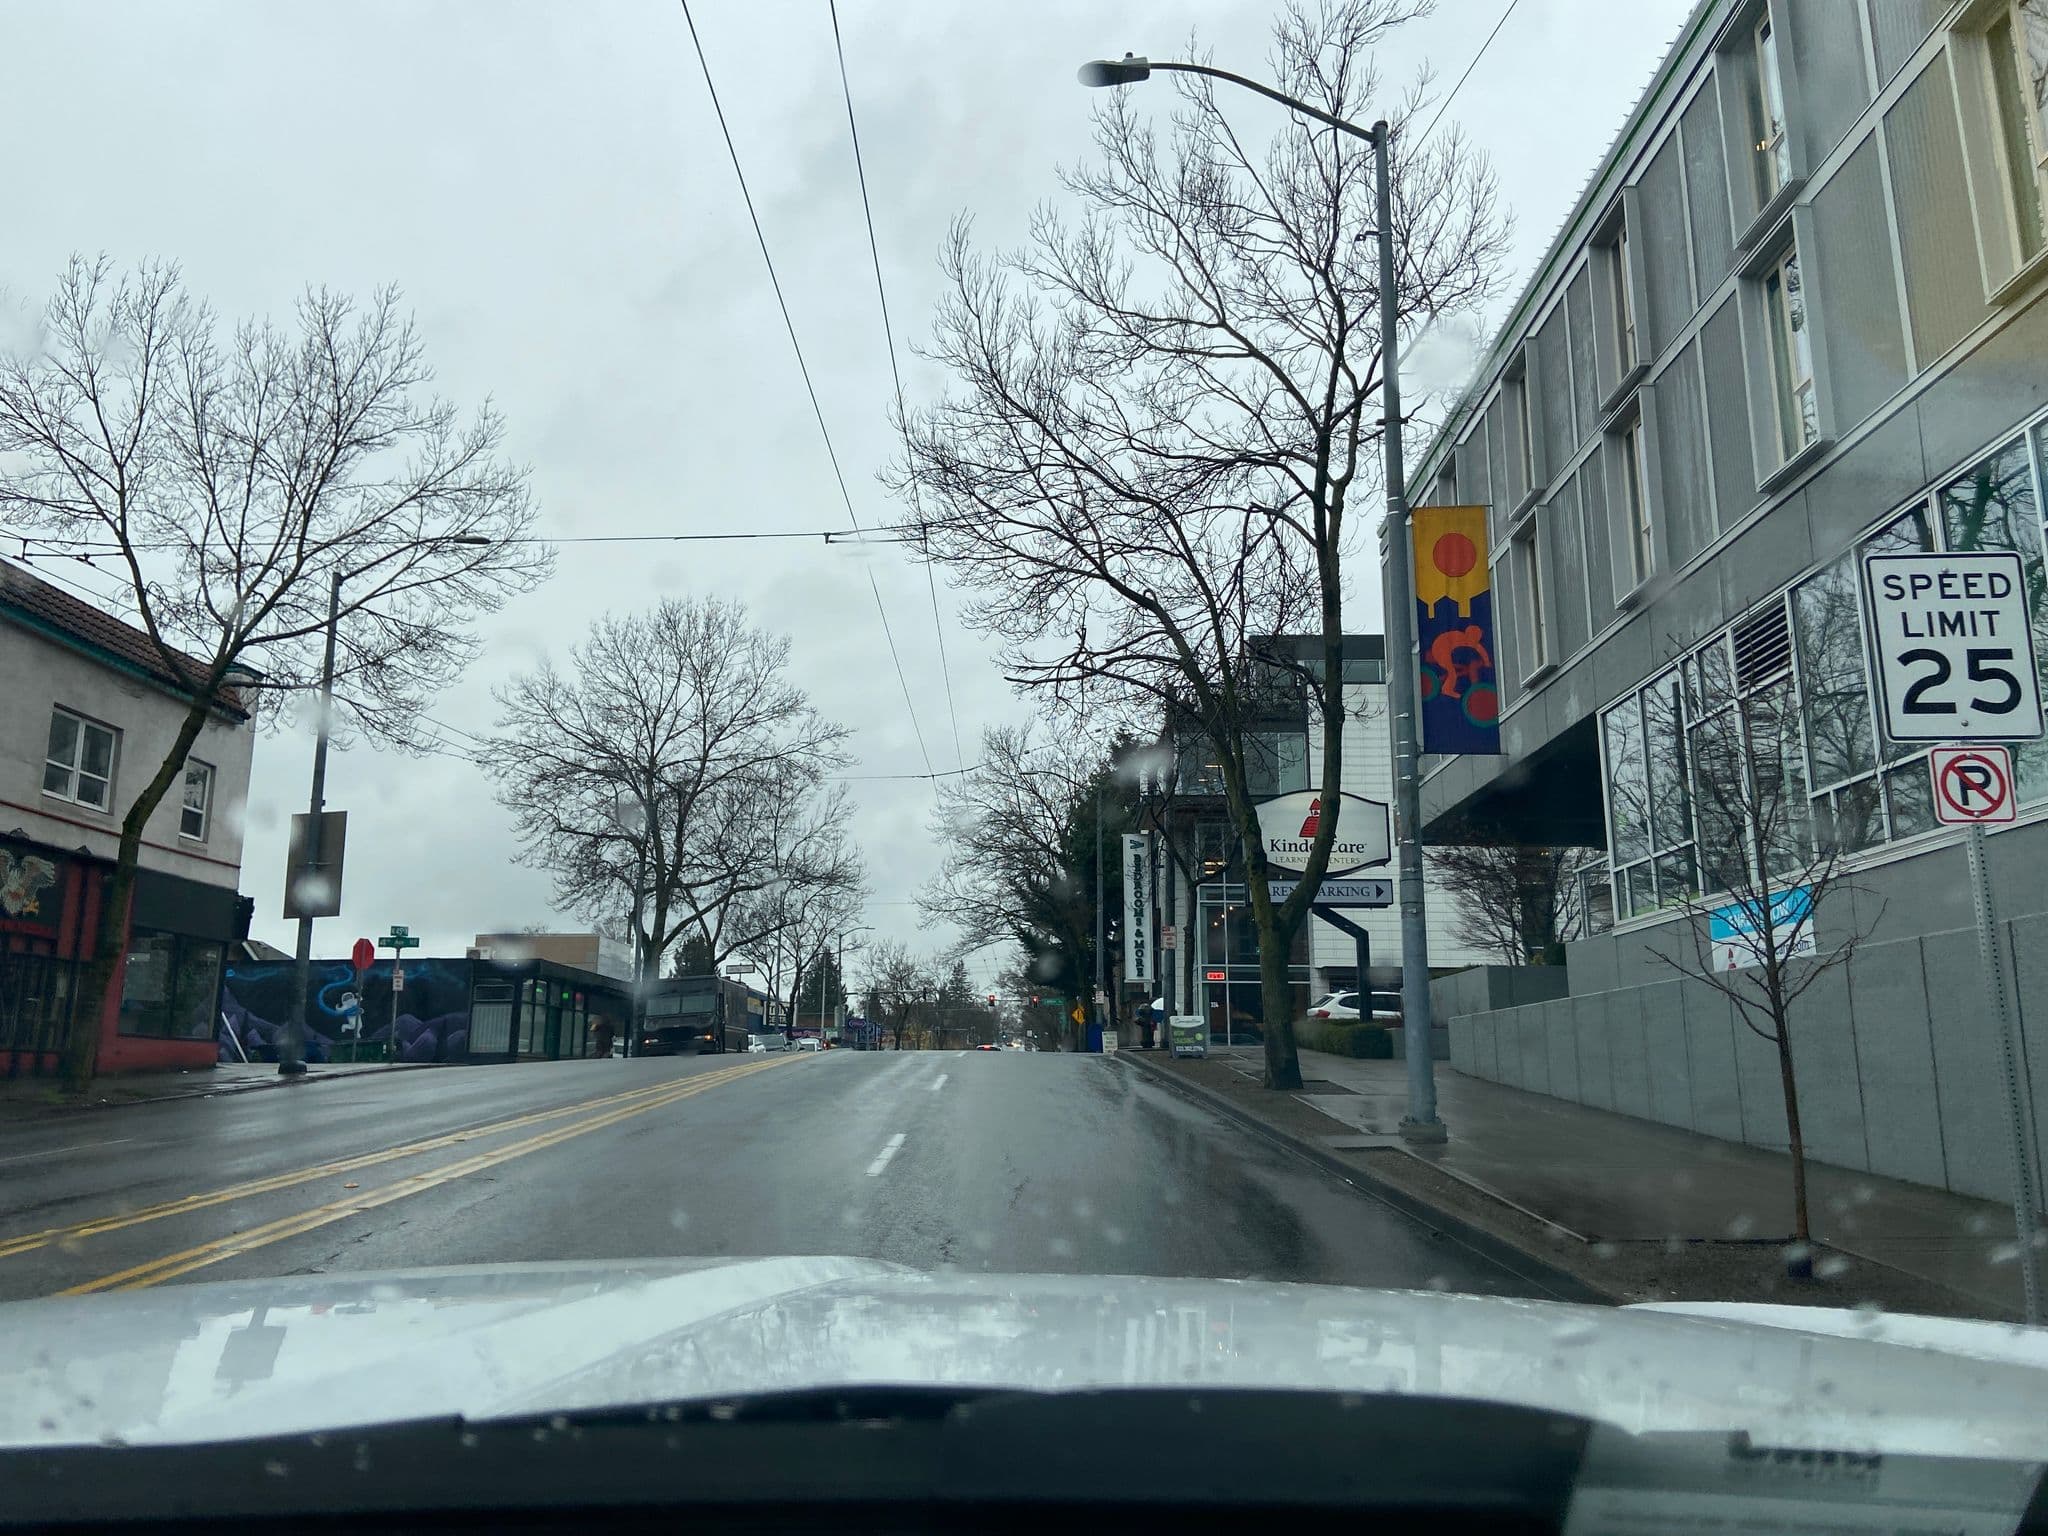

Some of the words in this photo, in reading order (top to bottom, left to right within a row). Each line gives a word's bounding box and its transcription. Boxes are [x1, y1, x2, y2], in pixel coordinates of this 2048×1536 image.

[1883, 572, 2012, 601] SPEED
[1901, 610, 2001, 638] LIMIT
[1897, 648, 2022, 715] 25
[1329, 857, 1360, 865] ENTERS
[1318, 886, 1370, 897] ARKING
